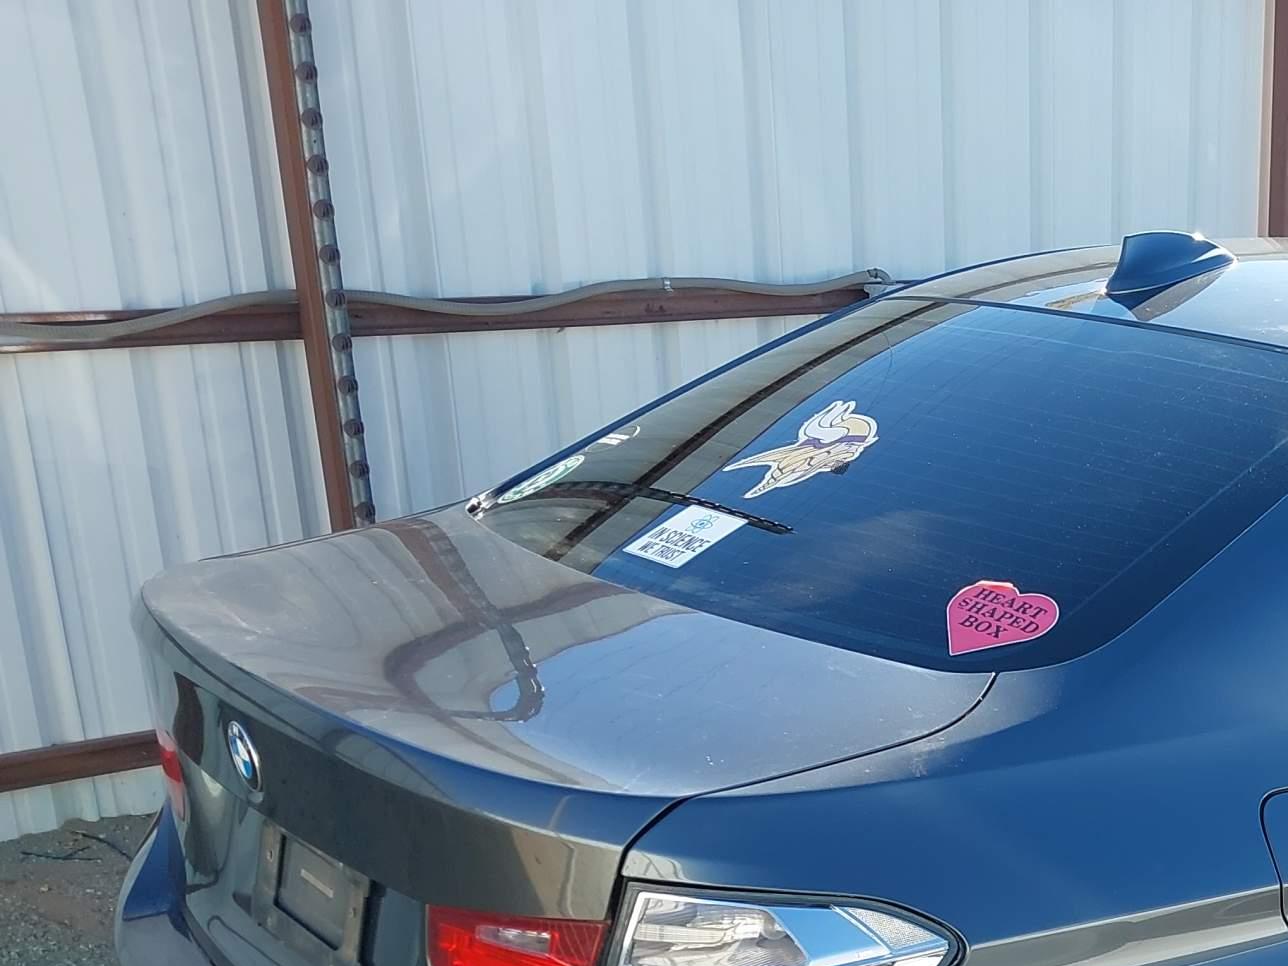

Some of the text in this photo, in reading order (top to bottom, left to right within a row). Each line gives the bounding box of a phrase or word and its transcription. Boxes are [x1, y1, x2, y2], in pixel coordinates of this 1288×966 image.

[637, 540, 687, 562] WE TRUST
[648, 527, 711, 553] IN SCIENCE
[958, 597, 1040, 635] SHAPED
[973, 587, 1048, 619] HEART
[958, 614, 1009, 639] BOX
